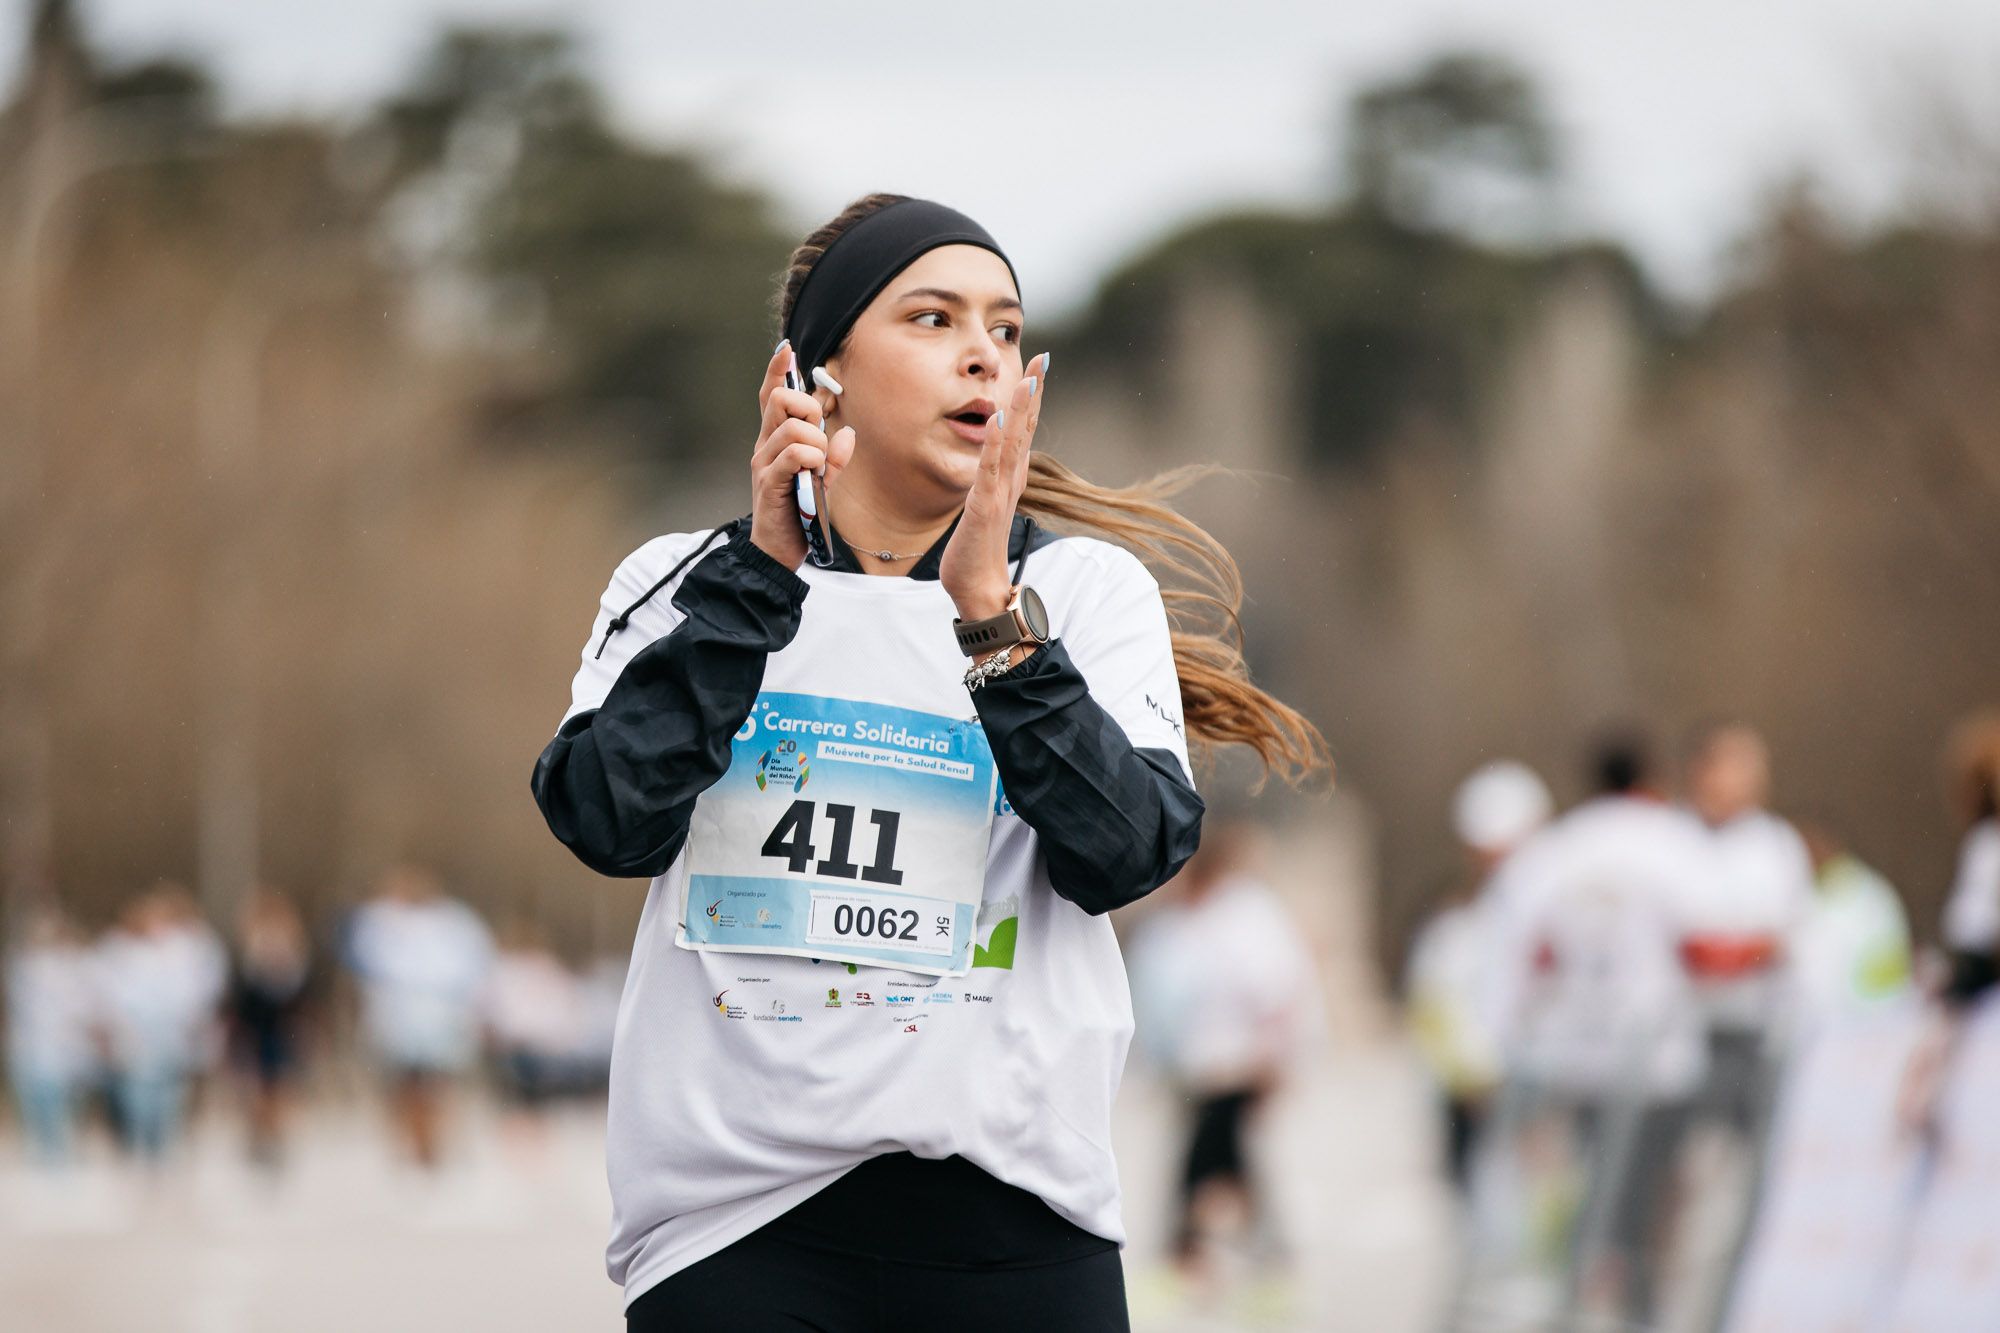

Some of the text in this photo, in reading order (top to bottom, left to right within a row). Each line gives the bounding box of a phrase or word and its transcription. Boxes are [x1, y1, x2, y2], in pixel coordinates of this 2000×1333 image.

[764, 711, 847, 738] Carrera
[853, 720, 951, 754] Solidaria
[776, 739, 797, 753] 20
[824, 745, 969, 775] Muévete por la Salud Renal
[761, 799, 904, 886] 411
[727, 890, 756, 898] Organizado
[834, 904, 919, 941] 0062
[936, 916, 950, 937] 5K
